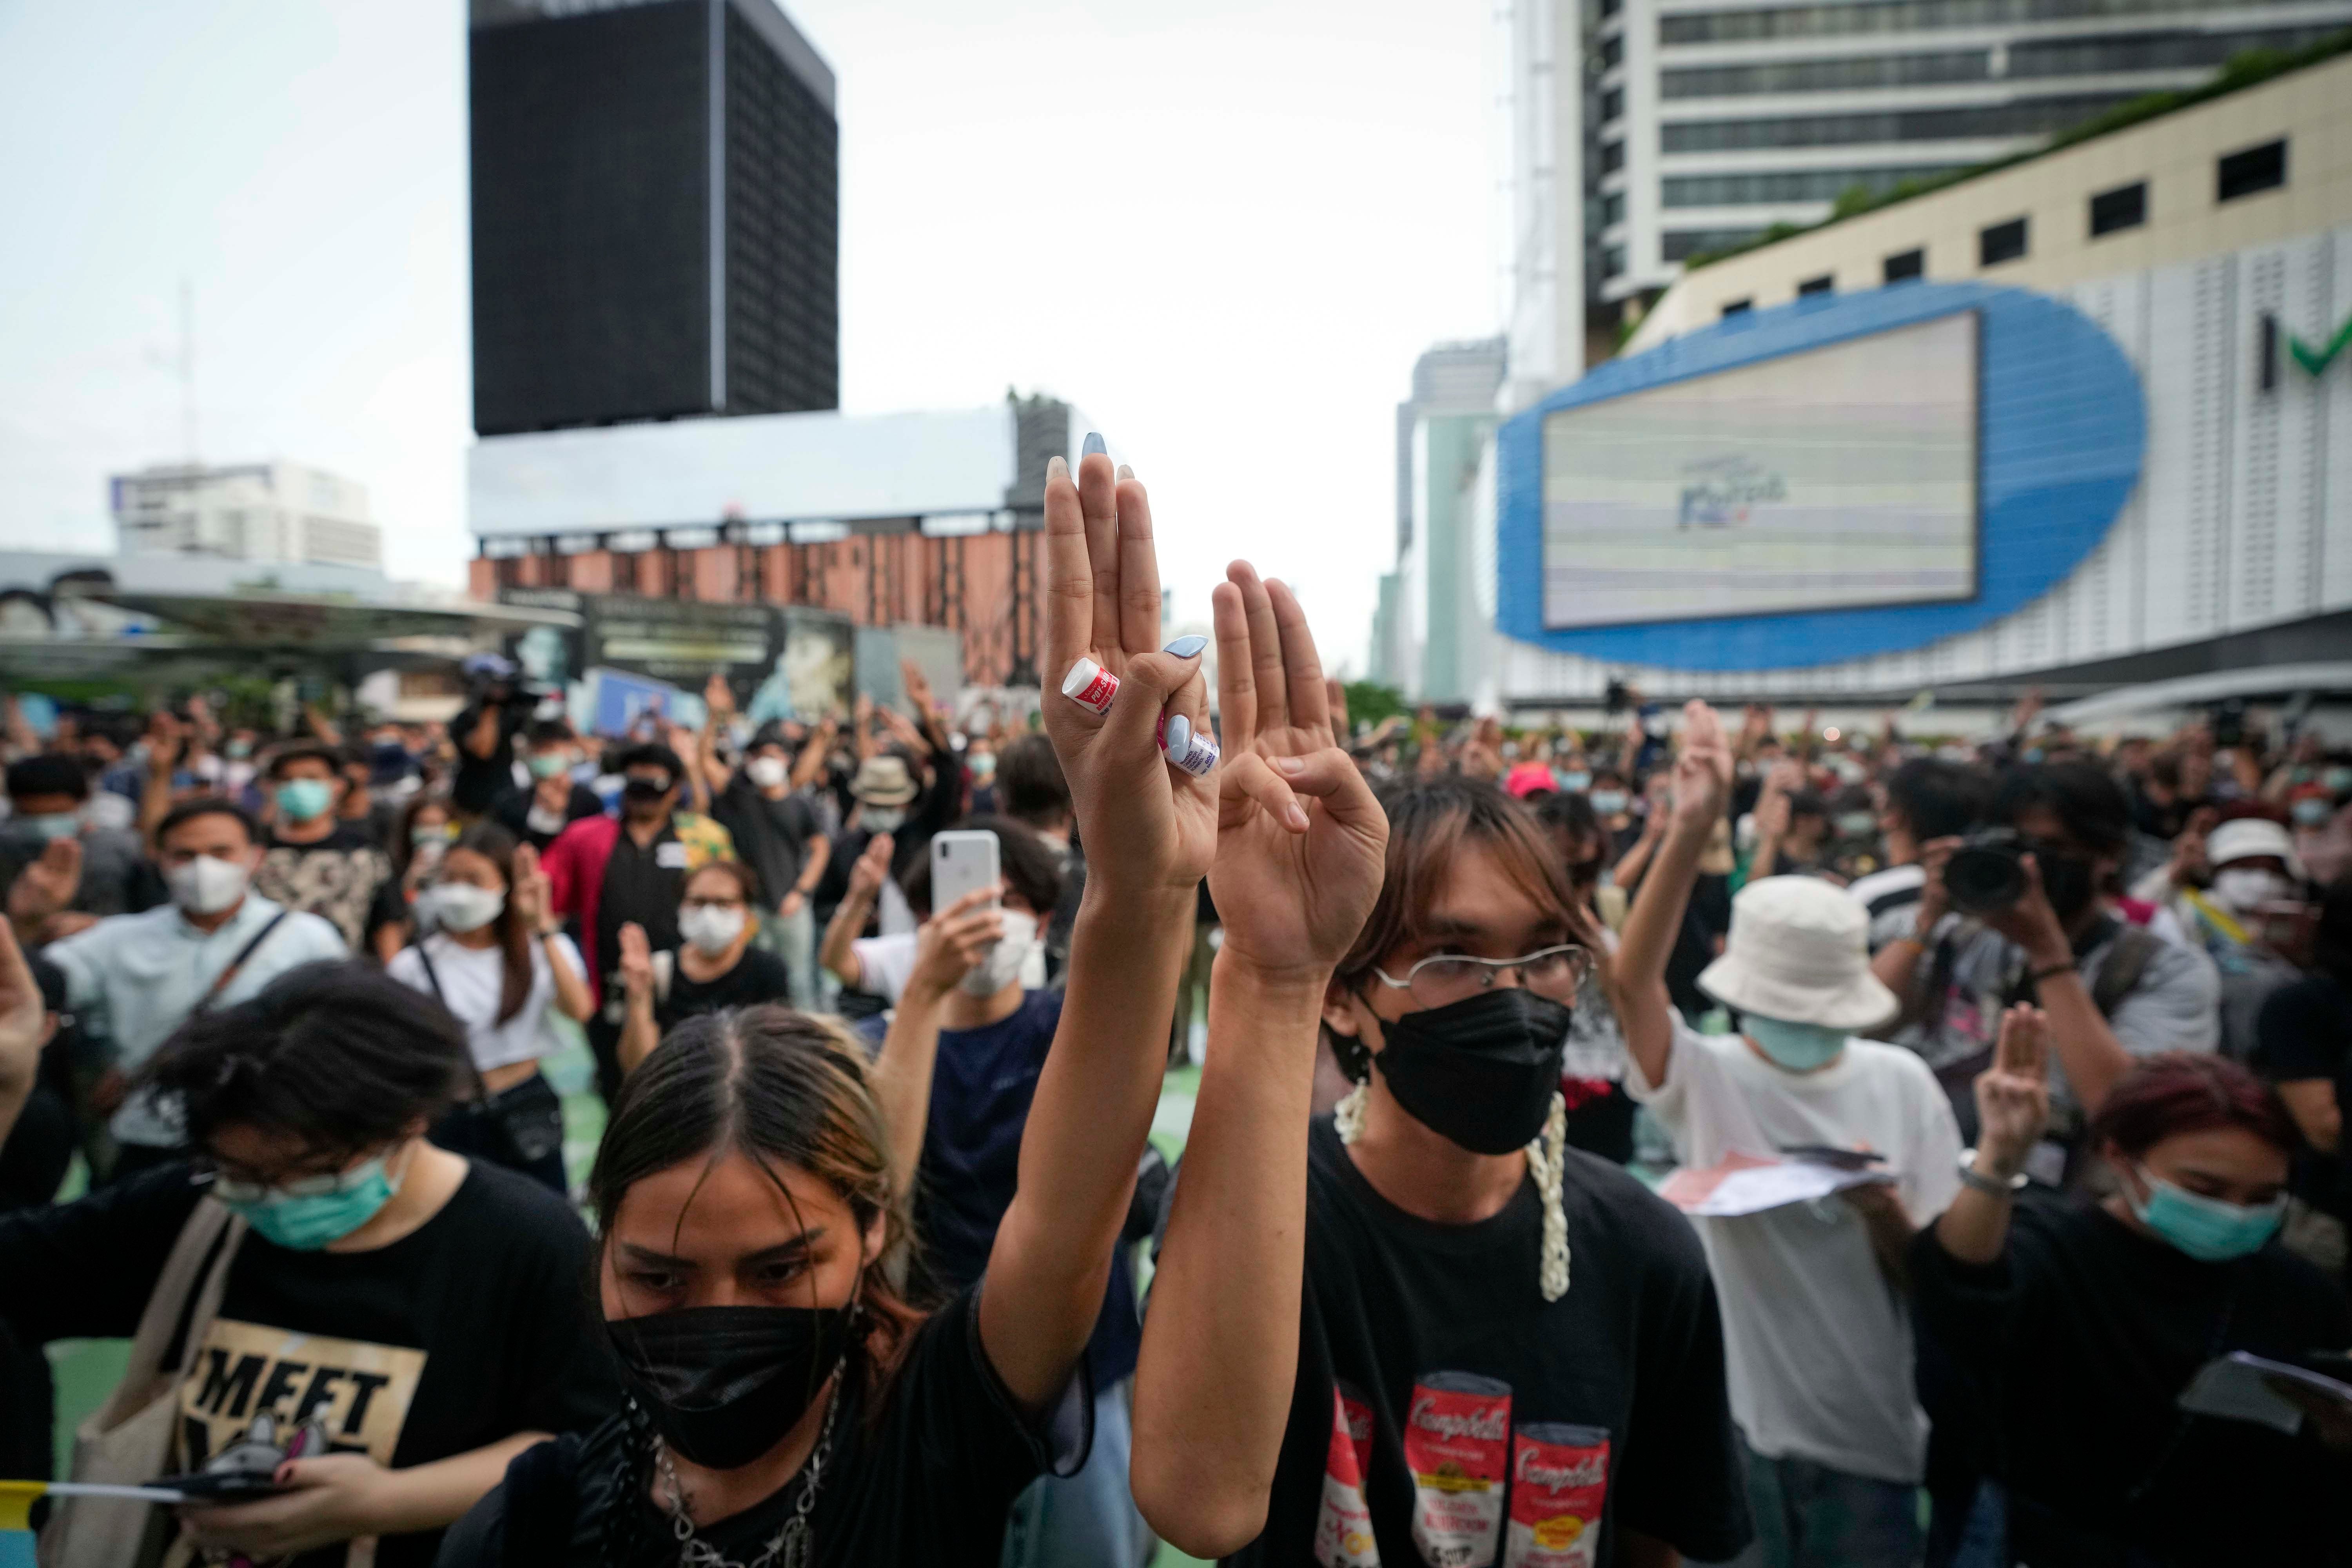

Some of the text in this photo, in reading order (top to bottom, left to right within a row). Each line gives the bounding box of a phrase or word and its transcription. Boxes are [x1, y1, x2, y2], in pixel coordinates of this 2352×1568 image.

[1096, 695, 1111, 711] BRAND
[1183, 751, 1198, 767] CAMPHOR
[1187, 749, 1204, 769] EUCALYPTUS
[1190, 757, 1204, 771] BORNEOL
